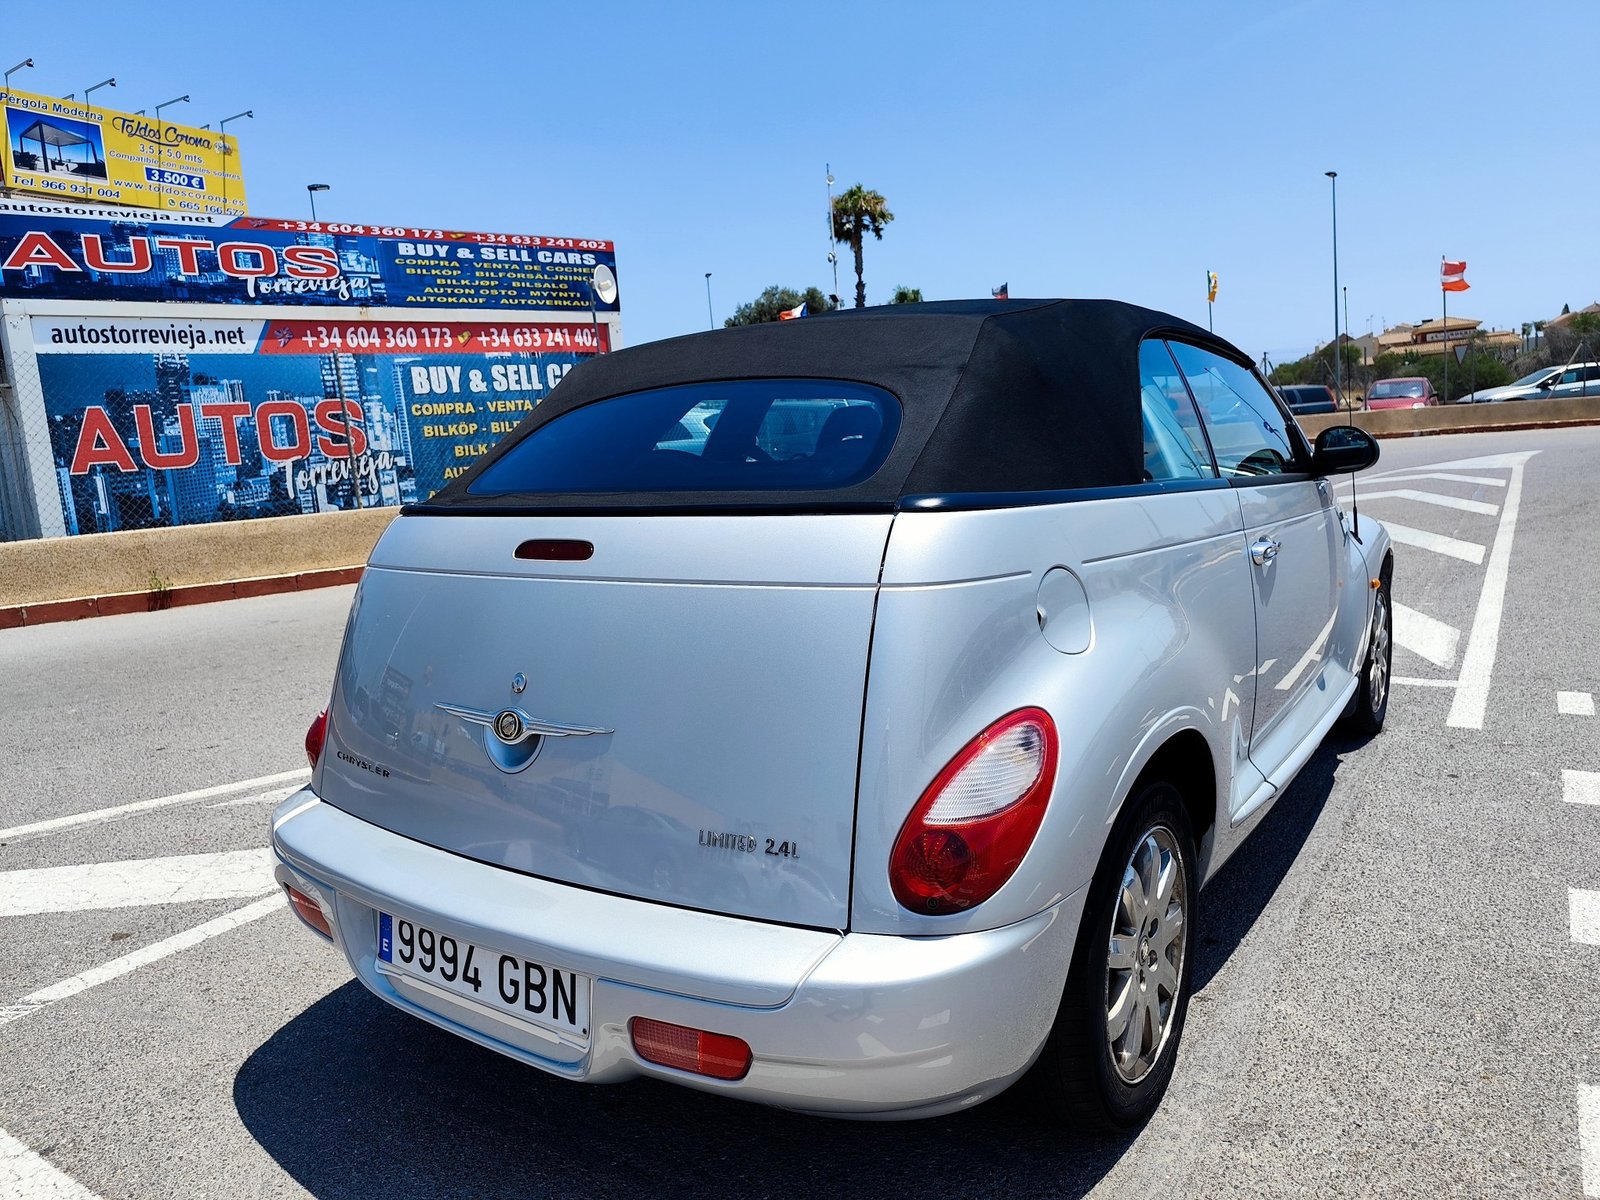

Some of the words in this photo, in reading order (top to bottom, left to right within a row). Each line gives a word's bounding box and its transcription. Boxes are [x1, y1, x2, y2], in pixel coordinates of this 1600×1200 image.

[0, 92, 48, 108] Pérgola
[52, 103, 104, 121] Moderna
[111, 116, 166, 143] Toldos
[164, 127, 213, 150] Corona
[109, 150, 160, 165] Compatible
[161, 160, 177, 168] con
[179, 164, 211, 175] paneles
[213, 170, 242, 180] solares
[12, 175, 37, 187] Tel.
[41, 179, 67, 191] 966
[70, 183, 93, 195] 931
[97, 188, 121, 199] 004
[150, 169, 189, 186] 3.500
[191, 177, 201, 189] €
[113, 180, 246, 207] www.toldoscorona.es
[0, 203, 216, 224] autostorrevieja.net
[179, 201, 201, 211] 665
[204, 204, 224, 215] 166
[225, 207, 246, 217] 572
[277, 220, 322, 233] +34
[327, 222, 365, 234] 604
[370, 225, 406, 237] 360
[410, 228, 445, 239] 173
[472, 232, 508, 243] +34
[511, 234, 542, 246] 633
[546, 237, 575, 248] 241
[578, 239, 607, 250] 402
[1, 231, 341, 280] AUTOS
[394, 258, 460, 267] COMPRA
[473, 261, 520, 270] VENTA
[524, 264, 542, 272] DE
[397, 242, 450, 258] BUY
[456, 247, 475, 259] &
[479, 247, 533, 262] SELL
[537, 250, 597, 266] CARS
[405, 267, 462, 276] BILKÖP
[436, 278, 499, 287] BILKJØP
[511, 281, 569, 289] BILSALG
[238, 275, 370, 301] Torrevieja
[406, 295, 487, 304] AUTOKAUF
[424, 286, 475, 295] AUTON
[479, 288, 518, 296] OSTO
[529, 290, 581, 298] MYYNTI
[51, 324, 247, 350] autostorrevieja.net
[301, 326, 342, 348] +34
[346, 326, 381, 348] 604
[384, 327, 417, 348] 360
[421, 328, 453, 348] 173
[477, 328, 511, 347] +34
[513, 328, 542, 347] 633
[546, 328, 571, 347] 241
[410, 365, 462, 395] BUY
[468, 369, 488, 393] &
[490, 364, 544, 392] SELL
[411, 402, 475, 416] COMPRA
[486, 399, 534, 413] VENTA
[70, 398, 367, 475] AUTOS
[423, 421, 478, 437] BILKÖP
[278, 448, 396, 500] Torreveja
[336, 751, 391, 778] CHRYSLER
[698, 829, 758, 853] LIMITED
[382, 937, 390, 953] E
[398, 919, 482, 993] 9994
[498, 954, 577, 1026] GBN
